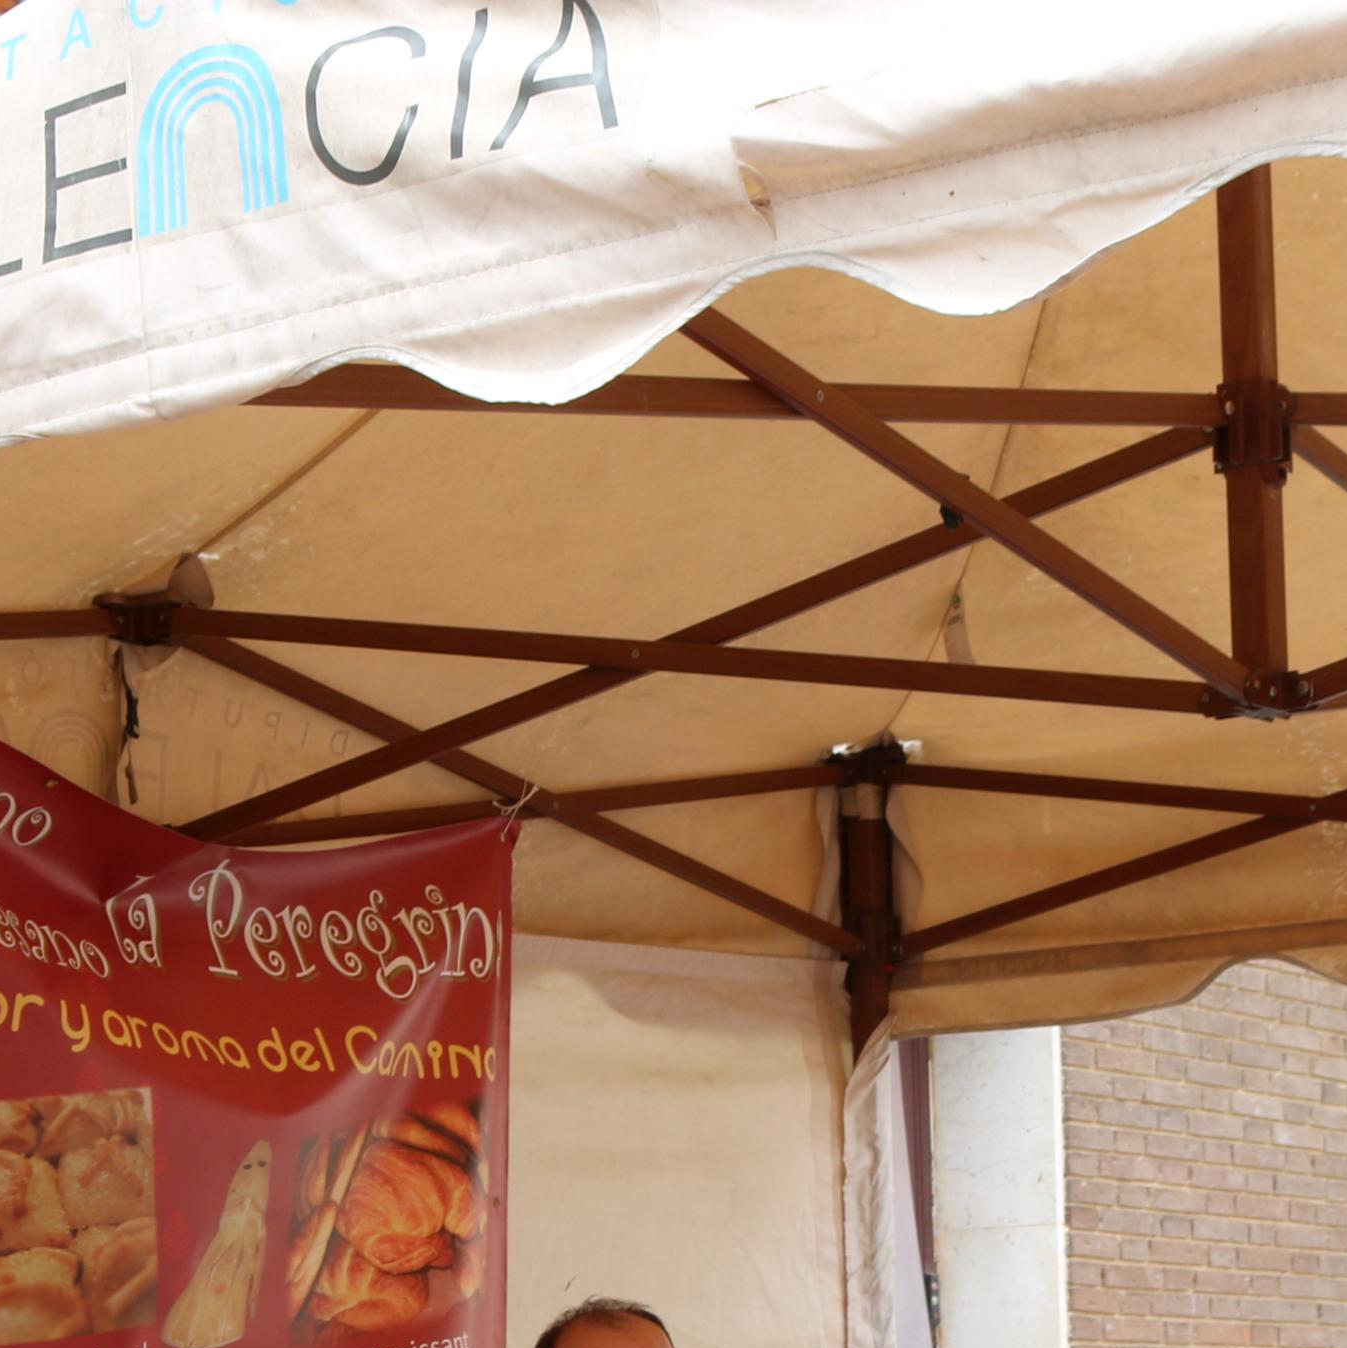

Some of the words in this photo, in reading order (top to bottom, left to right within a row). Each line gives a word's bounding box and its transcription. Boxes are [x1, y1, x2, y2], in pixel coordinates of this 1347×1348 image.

[187, 858, 502, 1000] Peregrin
[60, 999, 92, 1052] y
[101, 1008, 251, 1070] aroma
[257, 1026, 336, 1073] del
